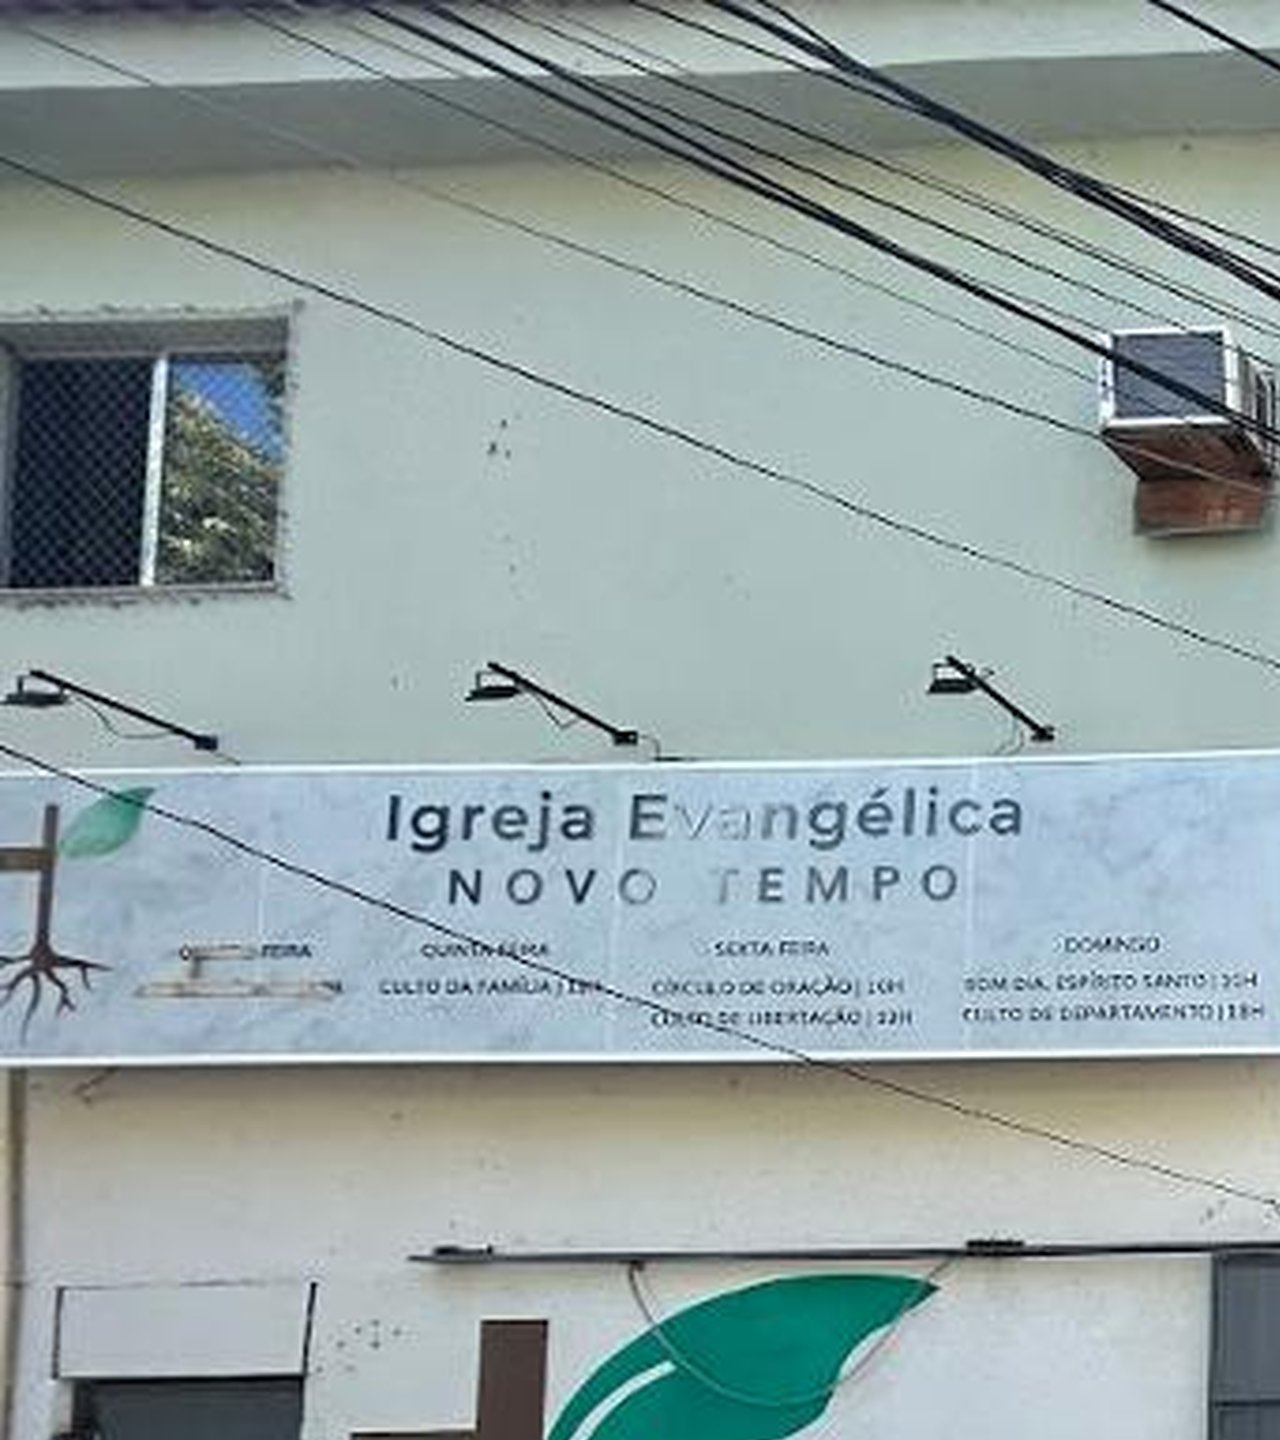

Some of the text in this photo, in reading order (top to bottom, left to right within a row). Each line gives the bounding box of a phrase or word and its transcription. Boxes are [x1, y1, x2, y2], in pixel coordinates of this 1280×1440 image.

[385, 786, 1023, 853] Igreja Evangélica
[448, 864, 958, 905] NOVO TEMPO
[715, 940, 829, 957] SEXTA FEIRA
[1065, 936, 1161, 953] DOMINGO
[379, 979, 439, 995] CULTO
[445, 979, 473, 995] DA
[478, 974, 551, 995] FAMÍLIA
[651, 975, 736, 996] CÍRCULO
[739, 980, 765, 995] DE
[769, 974, 852, 997] ORAÇÃO
[964, 975, 1008, 992] BOM
[1057, 970, 1138, 991] ESPÍRITO
[1143, 973, 1206, 989] SANTO
[748, 1006, 862, 1030] LIBERTAÇÃO
[962, 1005, 1023, 1022] CULTO
[1028, 1004, 1053, 1021] DE
[1059, 1003, 1213, 1021] DEPARTAMENTO
